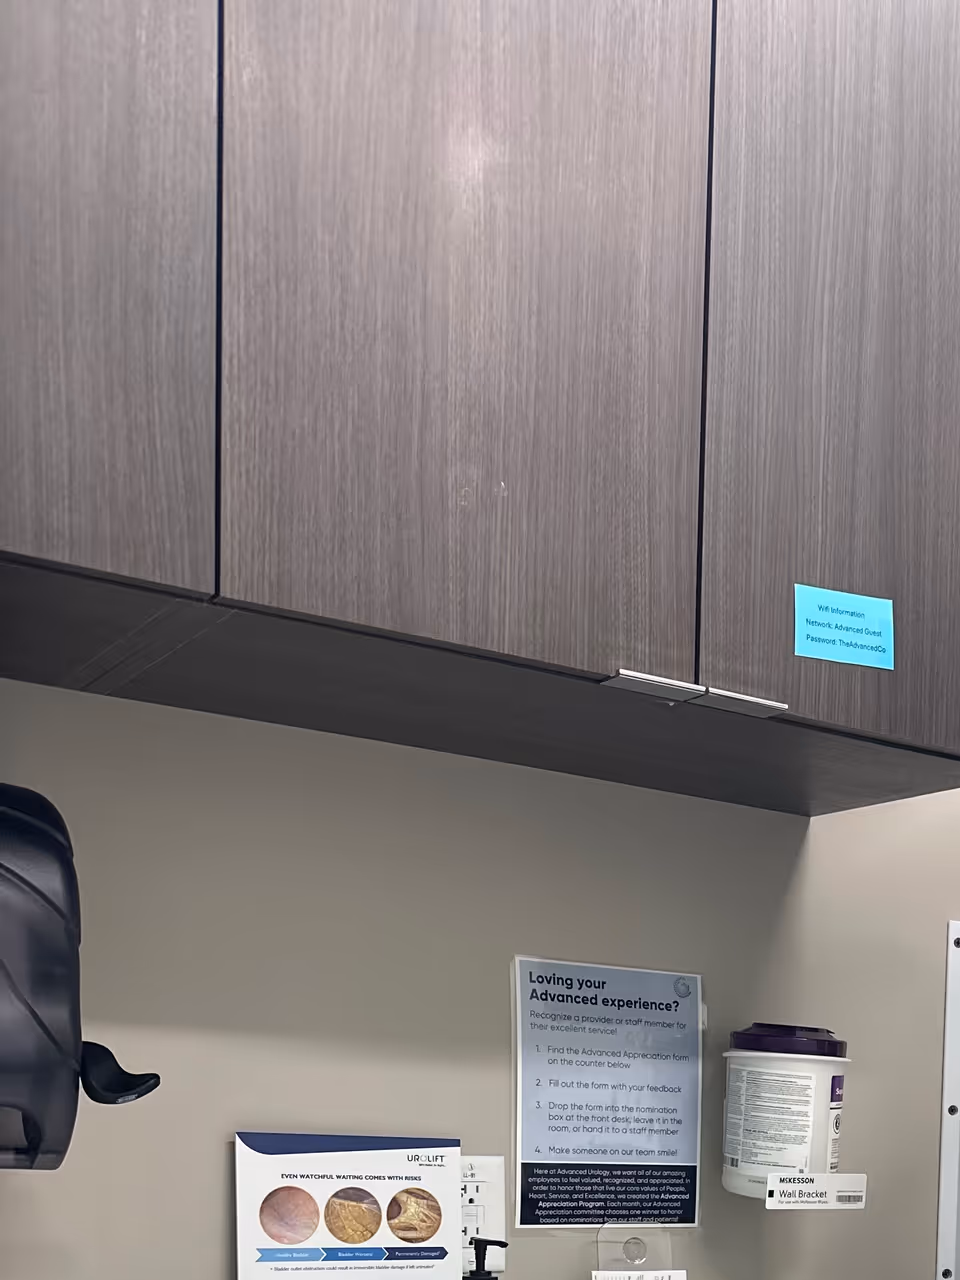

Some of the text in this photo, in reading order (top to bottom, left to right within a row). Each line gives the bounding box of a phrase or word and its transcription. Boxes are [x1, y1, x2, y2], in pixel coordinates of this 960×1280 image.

[818, 604, 865, 619] Wifi Information
[806, 618, 882, 638] Network: Advanced Guest
[807, 634, 837, 645] Password:
[529, 971, 606, 990] Loving your
[529, 989, 679, 1012] Advanced experience?
[530, 1010, 572, 1022] Recognize
[582, 1015, 613, 1024] provider
[625, 1018, 642, 1026] staff
[644, 1020, 675, 1028] member
[551, 1024, 586, 1033] excellent
[588, 1027, 617, 1035] service!
[548, 1045, 564, 1054] Find
[581, 1048, 621, 1058] Advanced
[623, 1050, 671, 1061] Appreciation
[673, 1053, 689, 1062] form
[591, 1081, 609, 1090] form
[611, 1082, 627, 1091] with
[647, 1084, 681, 1093] feedback
[549, 1102, 568, 1111] Drop
[636, 1106, 677, 1114] nomination
[583, 1125, 603, 1133] hand
[629, 1126, 647, 1134] staff
[779, 1190, 827, 1198] Wall Bracket
